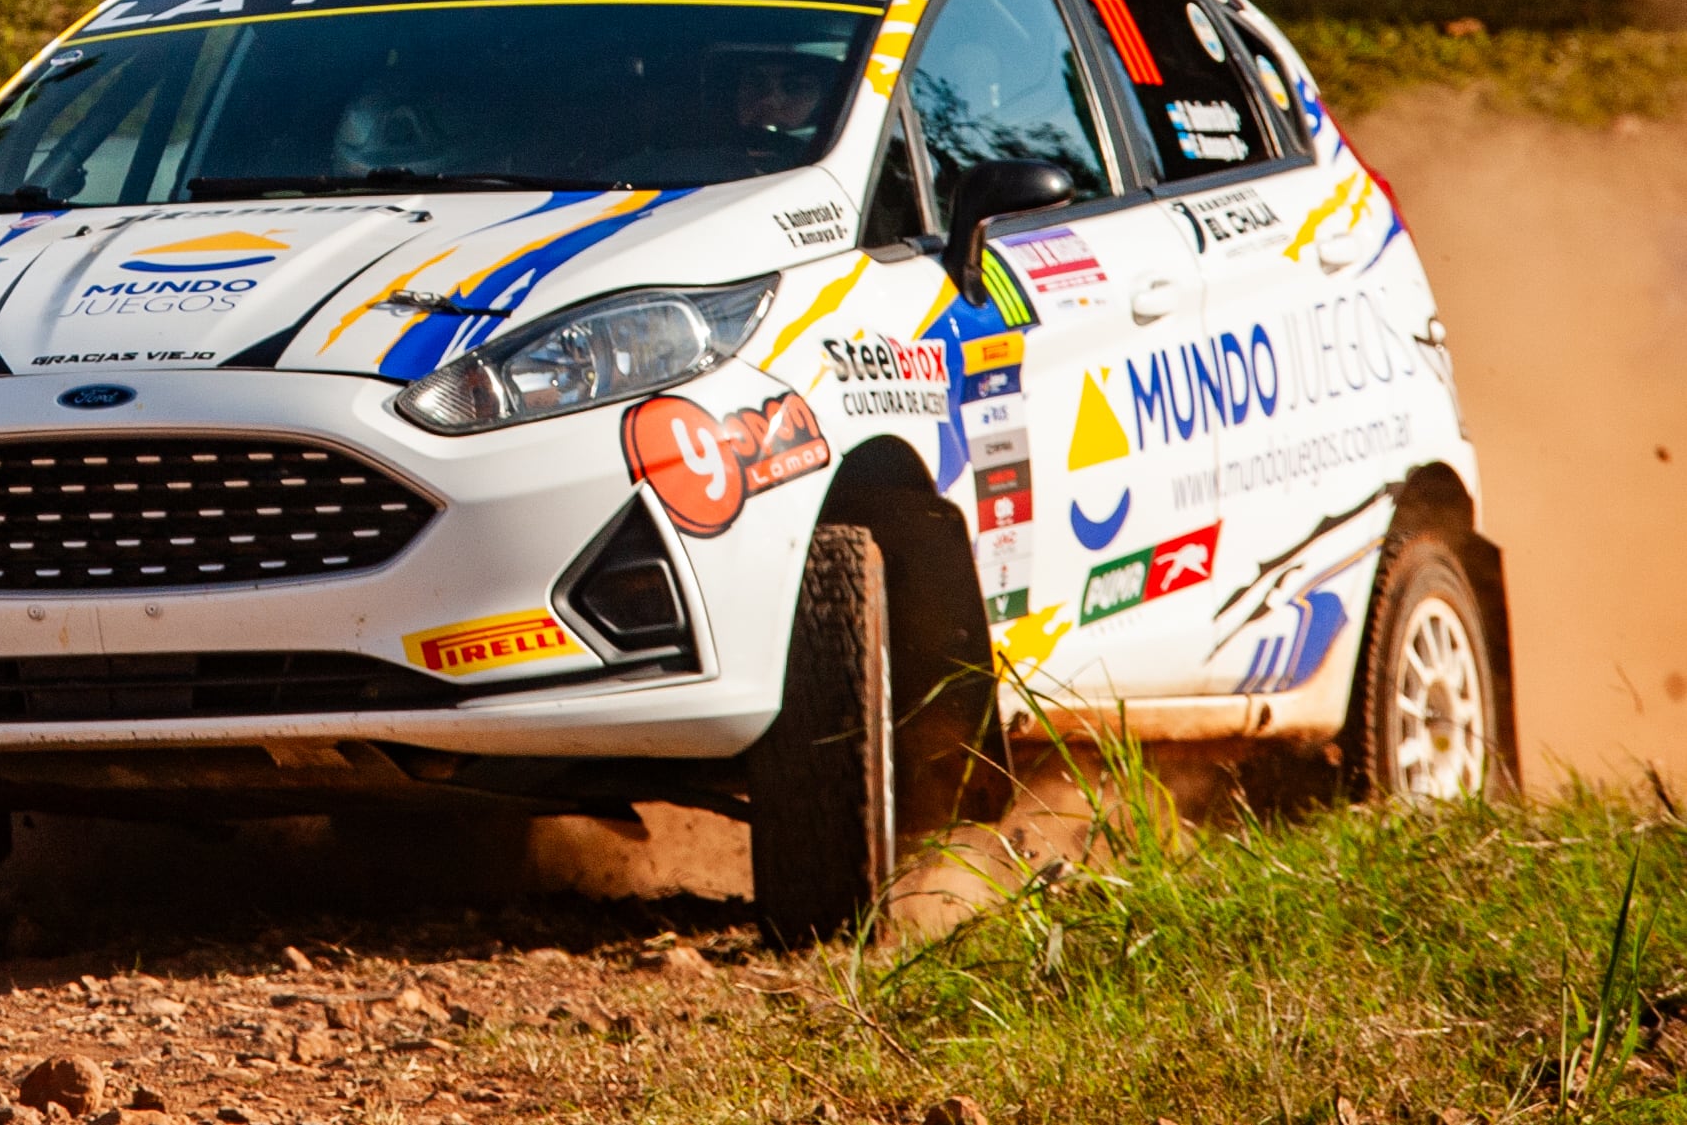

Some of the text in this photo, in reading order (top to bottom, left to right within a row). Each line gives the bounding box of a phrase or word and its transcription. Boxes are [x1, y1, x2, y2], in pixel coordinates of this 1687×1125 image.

[59, 294, 243, 318] JUEGOS
[81, 278, 258, 298] MUNDO
[30, 350, 217, 366] GRACIAS VIEJO
[824, 333, 948, 383] SteelBrox
[1126, 285, 1417, 451] MUNDO JUEGOS
[842, 390, 904, 417] CULTURA
[904, 390, 920, 414] DE
[1170, 412, 1415, 510] www.mundojuegos.com.ar
[1083, 560, 1147, 616] PUMA
[420, 617, 569, 672] PIRELLI
